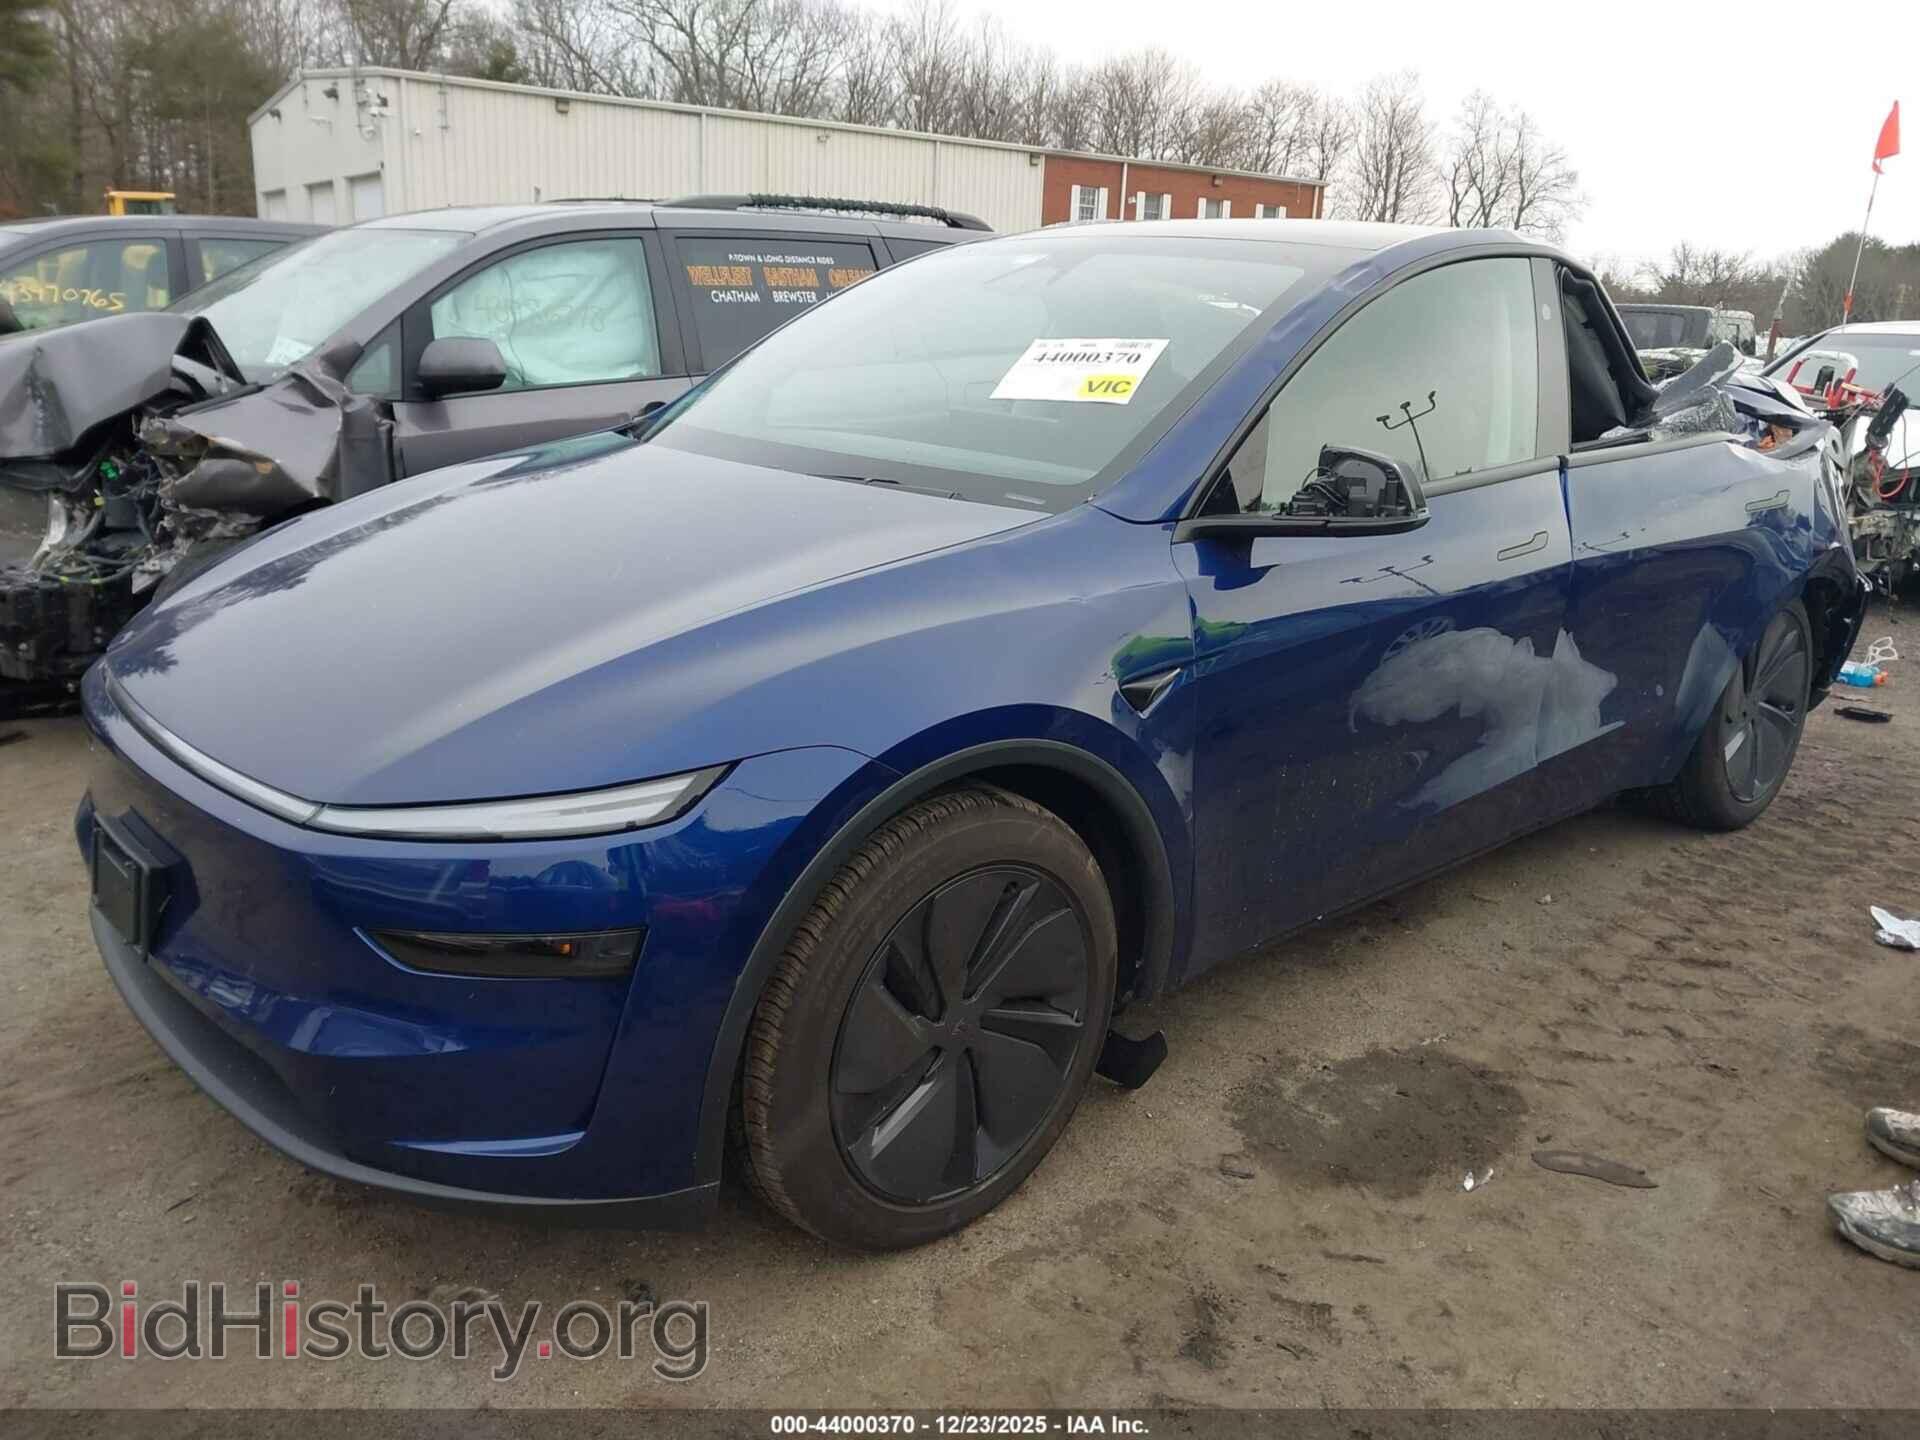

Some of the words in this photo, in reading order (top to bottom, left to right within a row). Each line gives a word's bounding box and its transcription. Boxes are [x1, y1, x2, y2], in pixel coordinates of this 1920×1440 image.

[757, 254, 763, 263] &
[763, 254, 784, 264] LONG
[784, 255, 816, 264] DISTANCE
[816, 256, 835, 265] RIDES
[711, 289, 761, 303] CHATHAM
[772, 290, 818, 303] BREWSTER
[1033, 351, 1142, 364] 44000370
[1086, 379, 1132, 394] VIC
